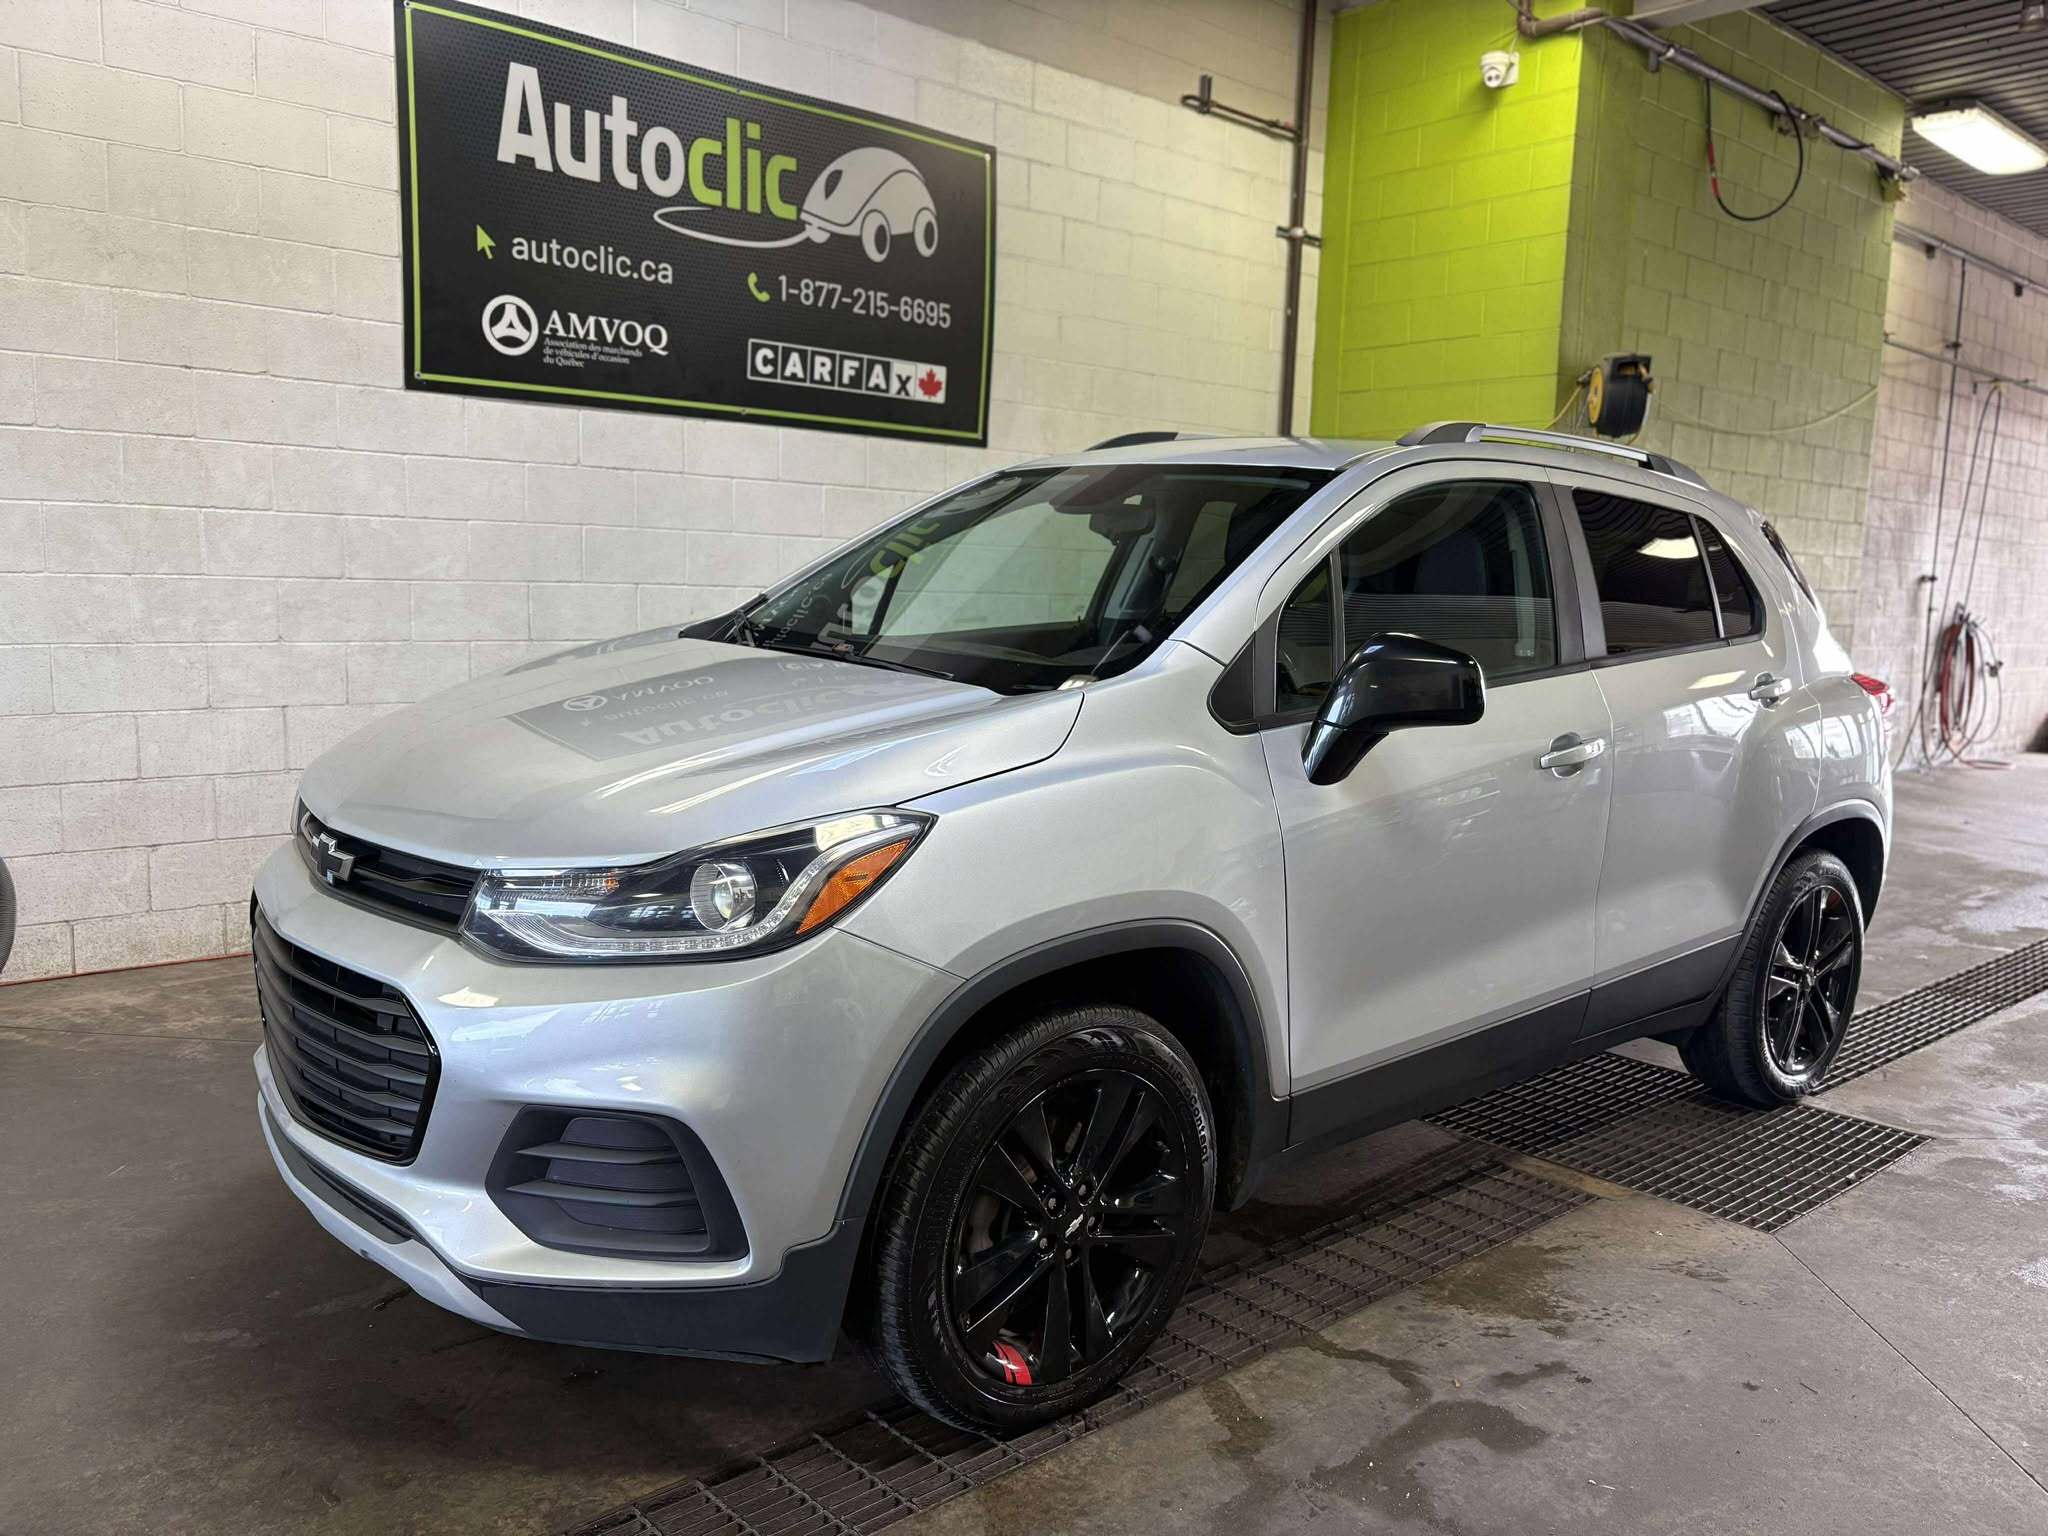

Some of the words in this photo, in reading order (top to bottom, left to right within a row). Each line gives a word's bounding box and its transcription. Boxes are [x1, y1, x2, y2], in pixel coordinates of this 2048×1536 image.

[497, 62, 797, 220] Autoclic
[511, 237, 673, 284] autoclic.ca
[778, 275, 951, 328] 1-877-215-6695
[543, 309, 669, 356] AMVOQ
[543, 337, 588, 352] Association
[588, 342, 602, 352] des
[754, 347, 913, 397] CARFAX
